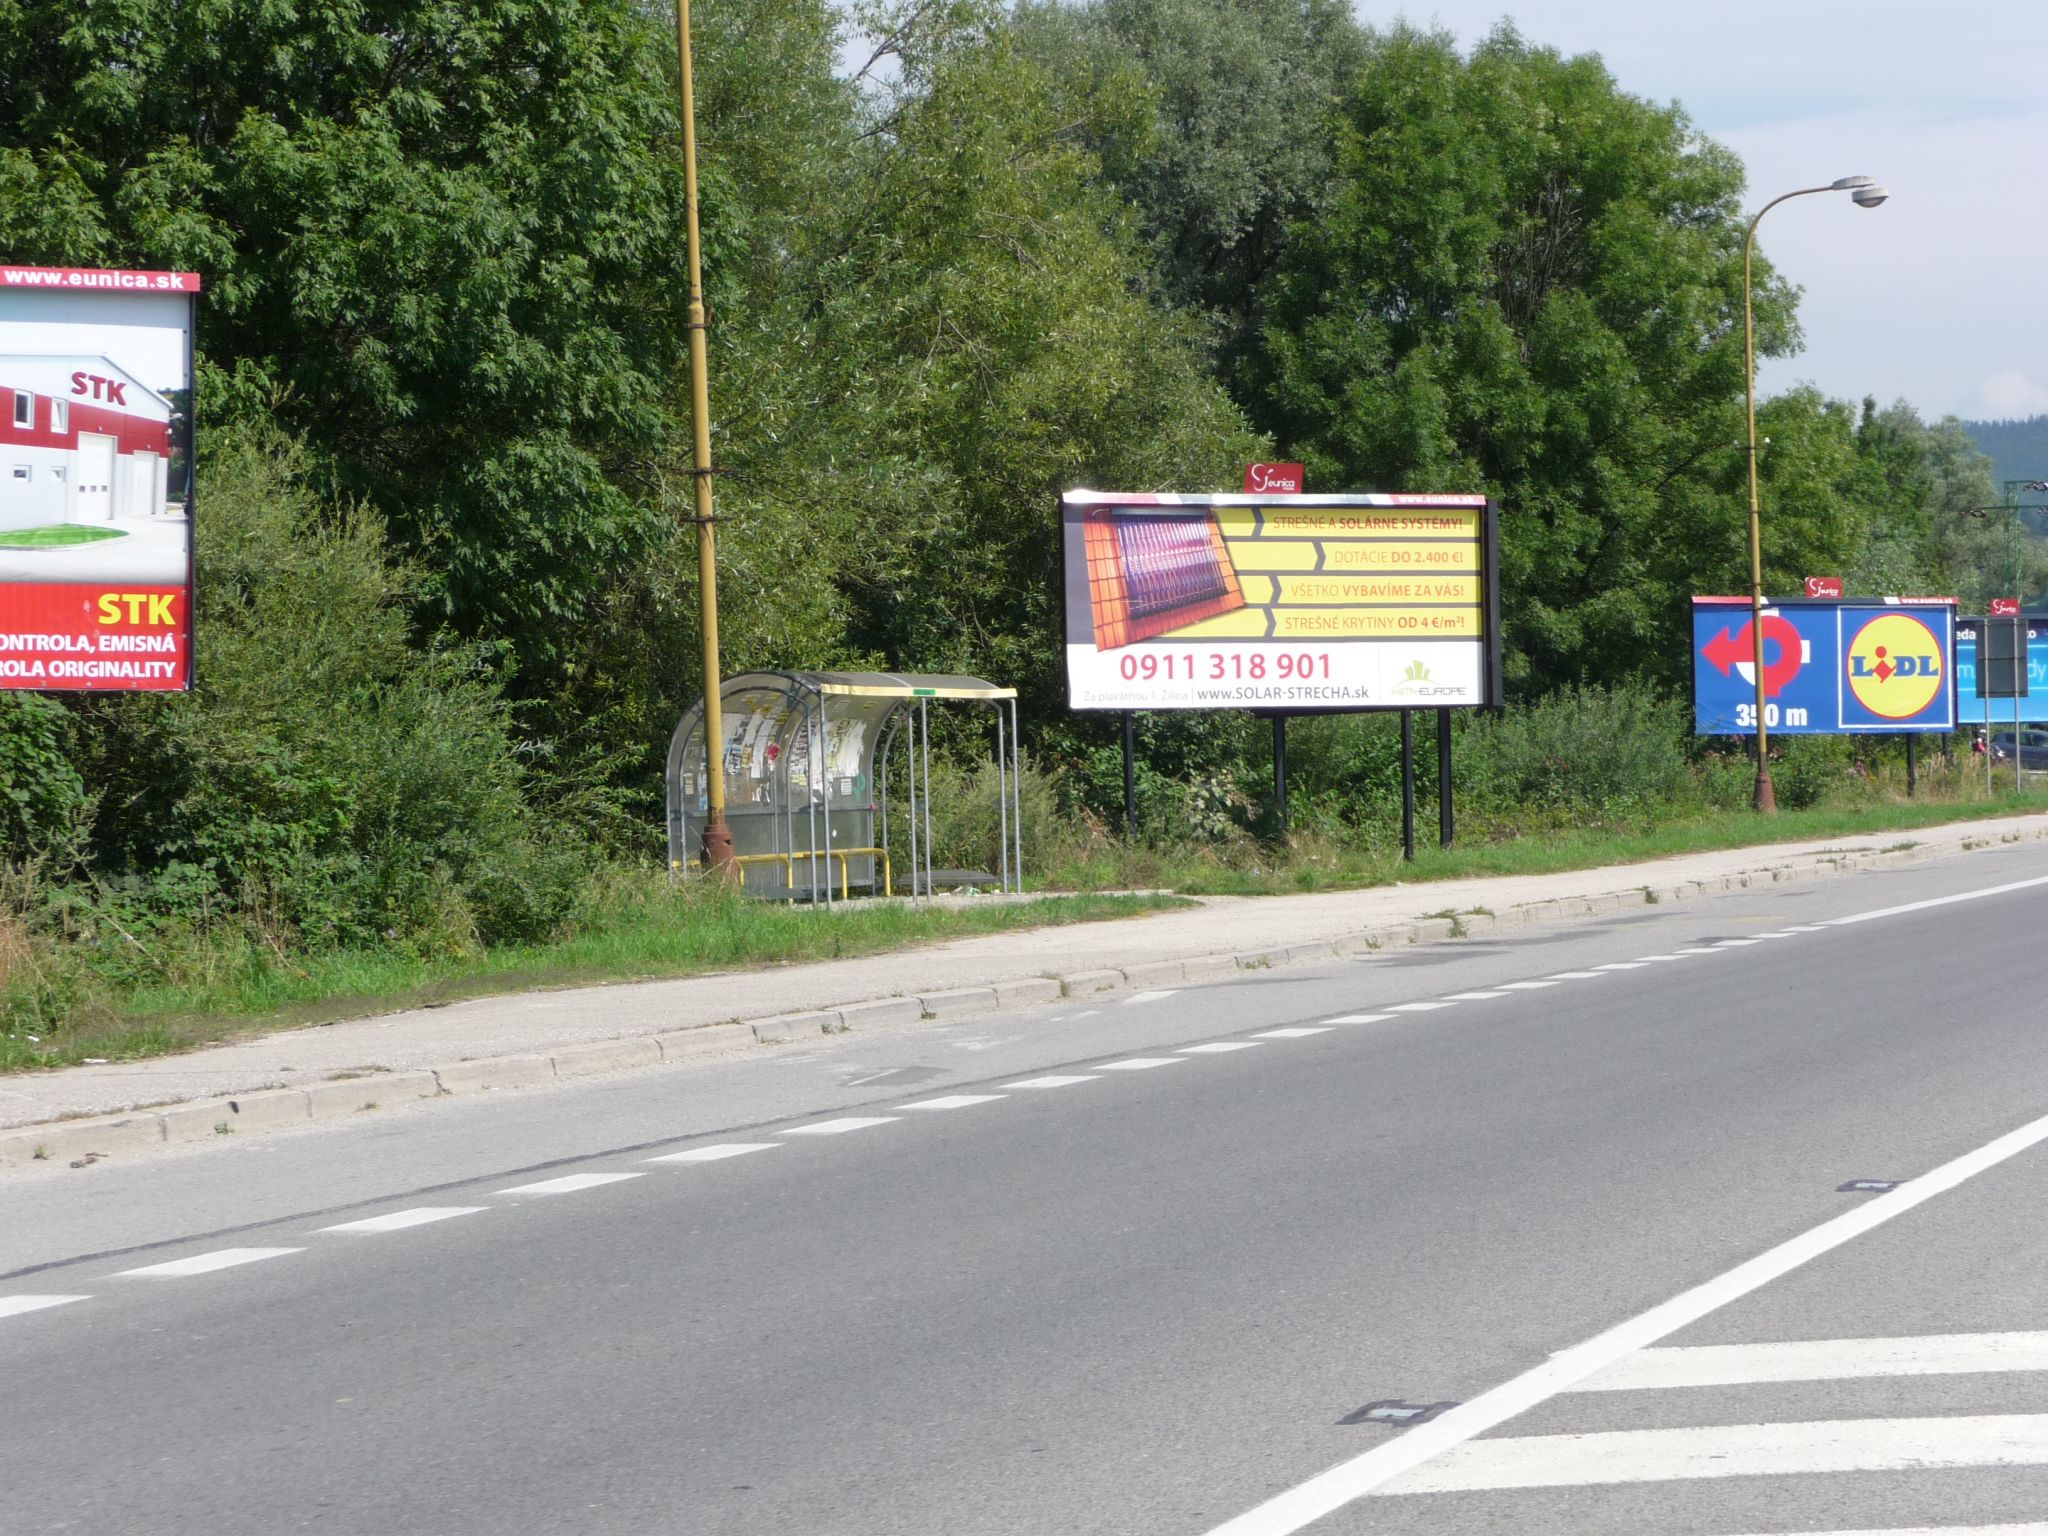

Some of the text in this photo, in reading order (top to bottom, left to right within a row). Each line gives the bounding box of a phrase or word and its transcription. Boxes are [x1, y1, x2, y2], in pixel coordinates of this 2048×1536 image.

[4, 270, 184, 289] www.eunica.sk
[71, 371, 127, 407] STK
[1273, 515, 1463, 529] STREŠNÉ A SOLÁRNE SYSTÉMY!
[1334, 550, 1387, 563] DOTÁCIE
[1391, 552, 1411, 563] DO
[1414, 552, 1448, 563] 2.400
[1291, 583, 1464, 597] VŠETKO VYBAVÍME ZA VÁS!
[97, 593, 176, 625] STK
[1285, 615, 1339, 629] STREŠNÉ
[1342, 617, 1394, 629] KRYTINY
[1397, 617, 1417, 629] OD
[1421, 617, 1429, 628] 4
[99, 632, 176, 652] EMISNÁ
[48, 660, 176, 678] ORIGINALITY
[1120, 653, 1331, 680] 0911 318 901
[1197, 685, 1370, 700] www.SOLAR-STRECHA.sk
[1785, 707, 1808, 727] m
